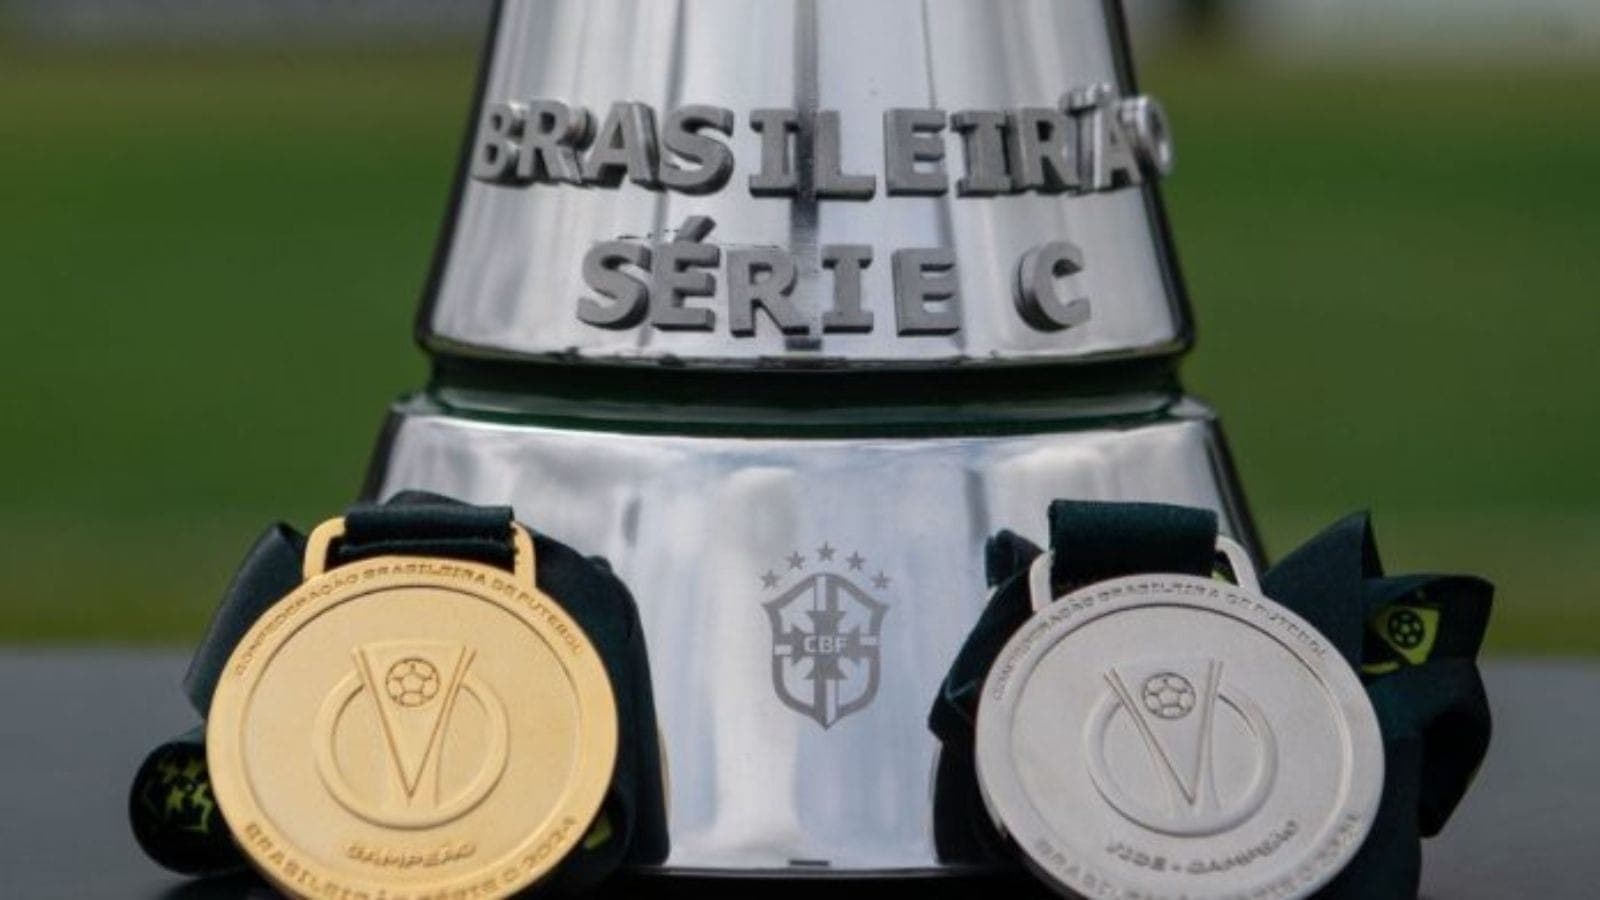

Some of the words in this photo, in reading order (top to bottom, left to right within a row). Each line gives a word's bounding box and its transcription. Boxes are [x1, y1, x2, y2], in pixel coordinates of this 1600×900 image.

[472, 83, 1175, 199] BRASILEIRÃO
[577, 216, 962, 338] SÉRIE
[1012, 241, 1093, 332] C
[363, 564, 486, 584] BRASILEIRA
[491, 578, 517, 596] DE
[518, 590, 583, 655] FUTEBOL
[803, 633, 849, 654] CBF
